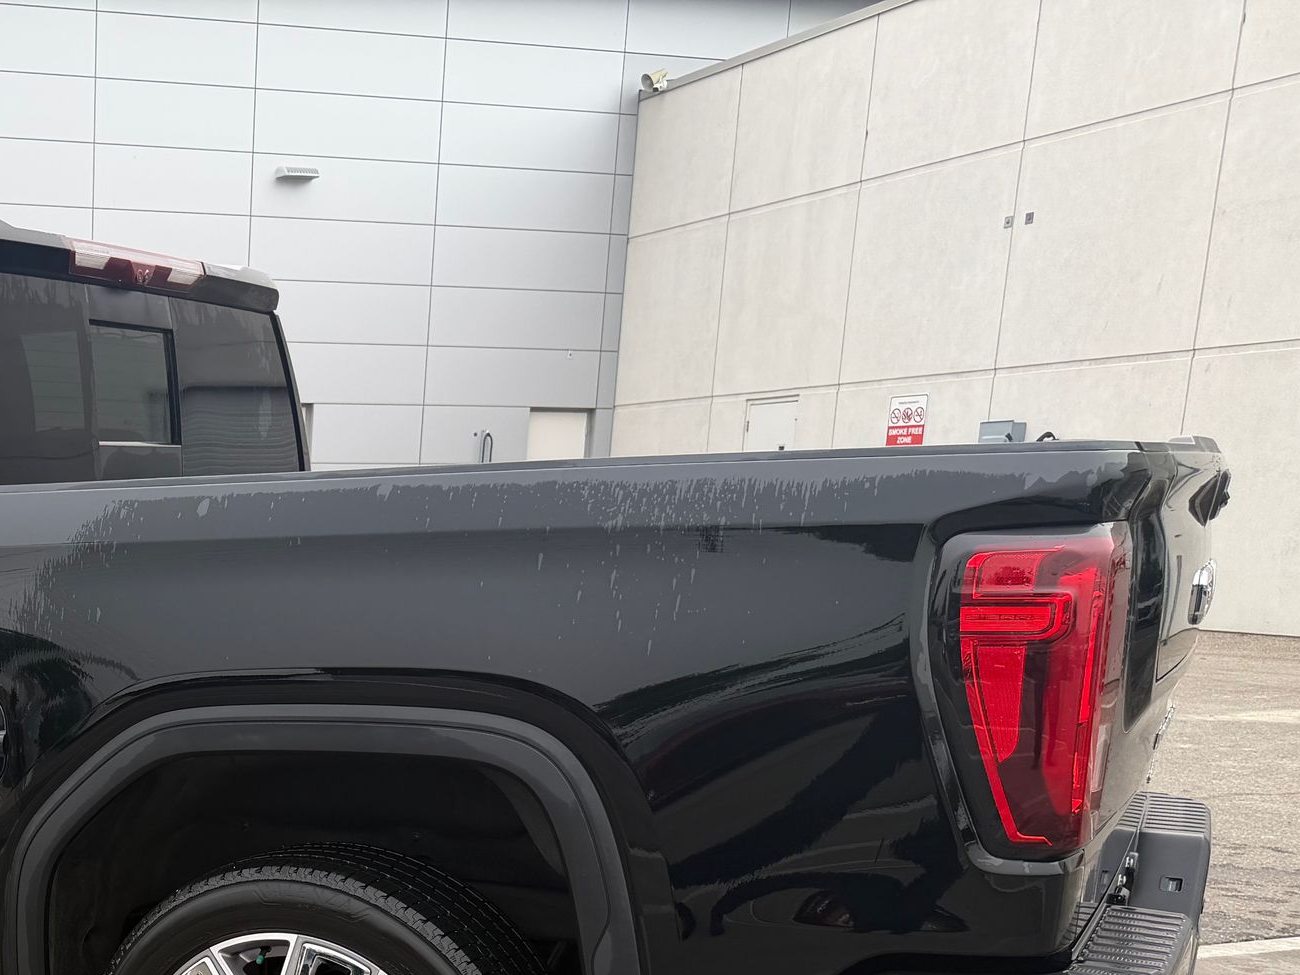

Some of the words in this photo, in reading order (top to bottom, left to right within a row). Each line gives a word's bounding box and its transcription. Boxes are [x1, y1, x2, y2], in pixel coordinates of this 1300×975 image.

[888, 428, 908, 436] SMOKE
[908, 427, 923, 435] FREE
[897, 436, 912, 444] ZONE
